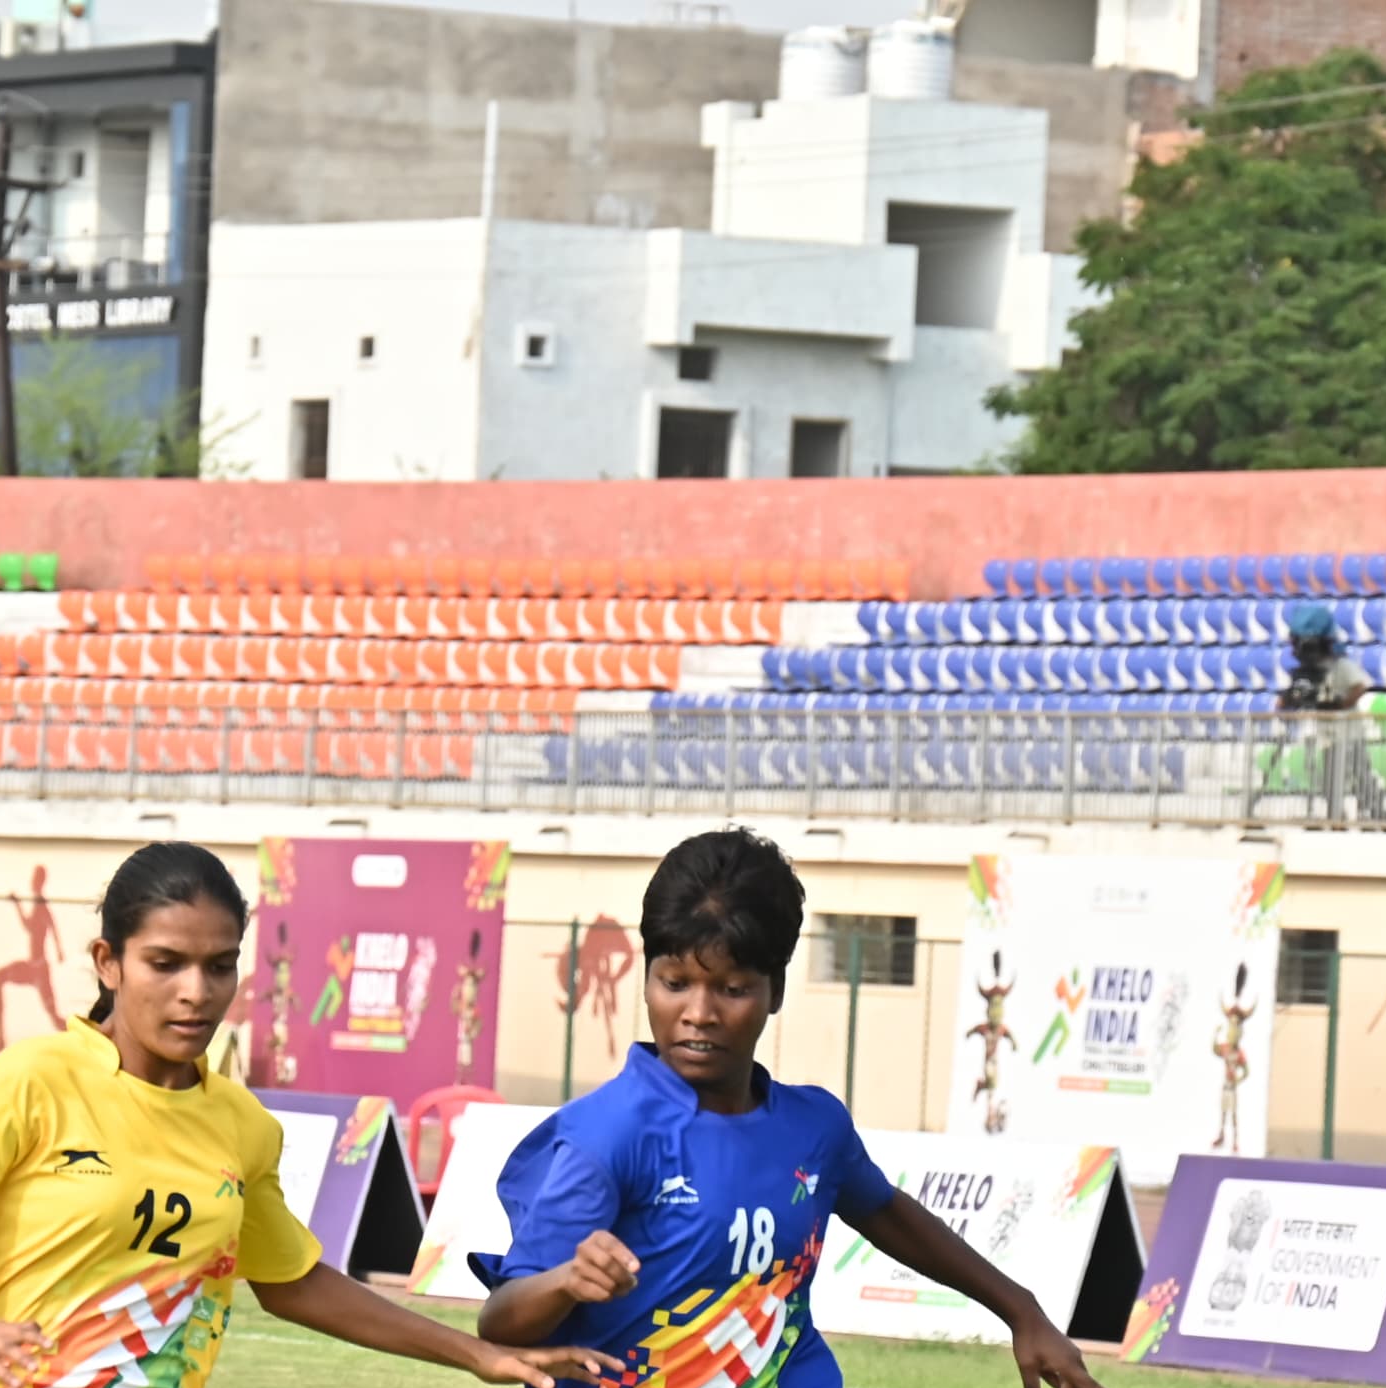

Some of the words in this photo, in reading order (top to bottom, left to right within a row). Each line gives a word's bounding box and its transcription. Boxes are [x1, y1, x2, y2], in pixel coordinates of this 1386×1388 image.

[1091, 966, 1153, 1002] KHELO
[1084, 1008, 1138, 1043] INDIA
[917, 1170, 994, 1212] KHELO
[128, 1188, 192, 1259] 12
[728, 1206, 775, 1275] 18
[1270, 1249, 1381, 1279] GOVERNMENT
[1263, 1281, 1284, 1305] OF
[1285, 1280, 1339, 1311] INDIA
